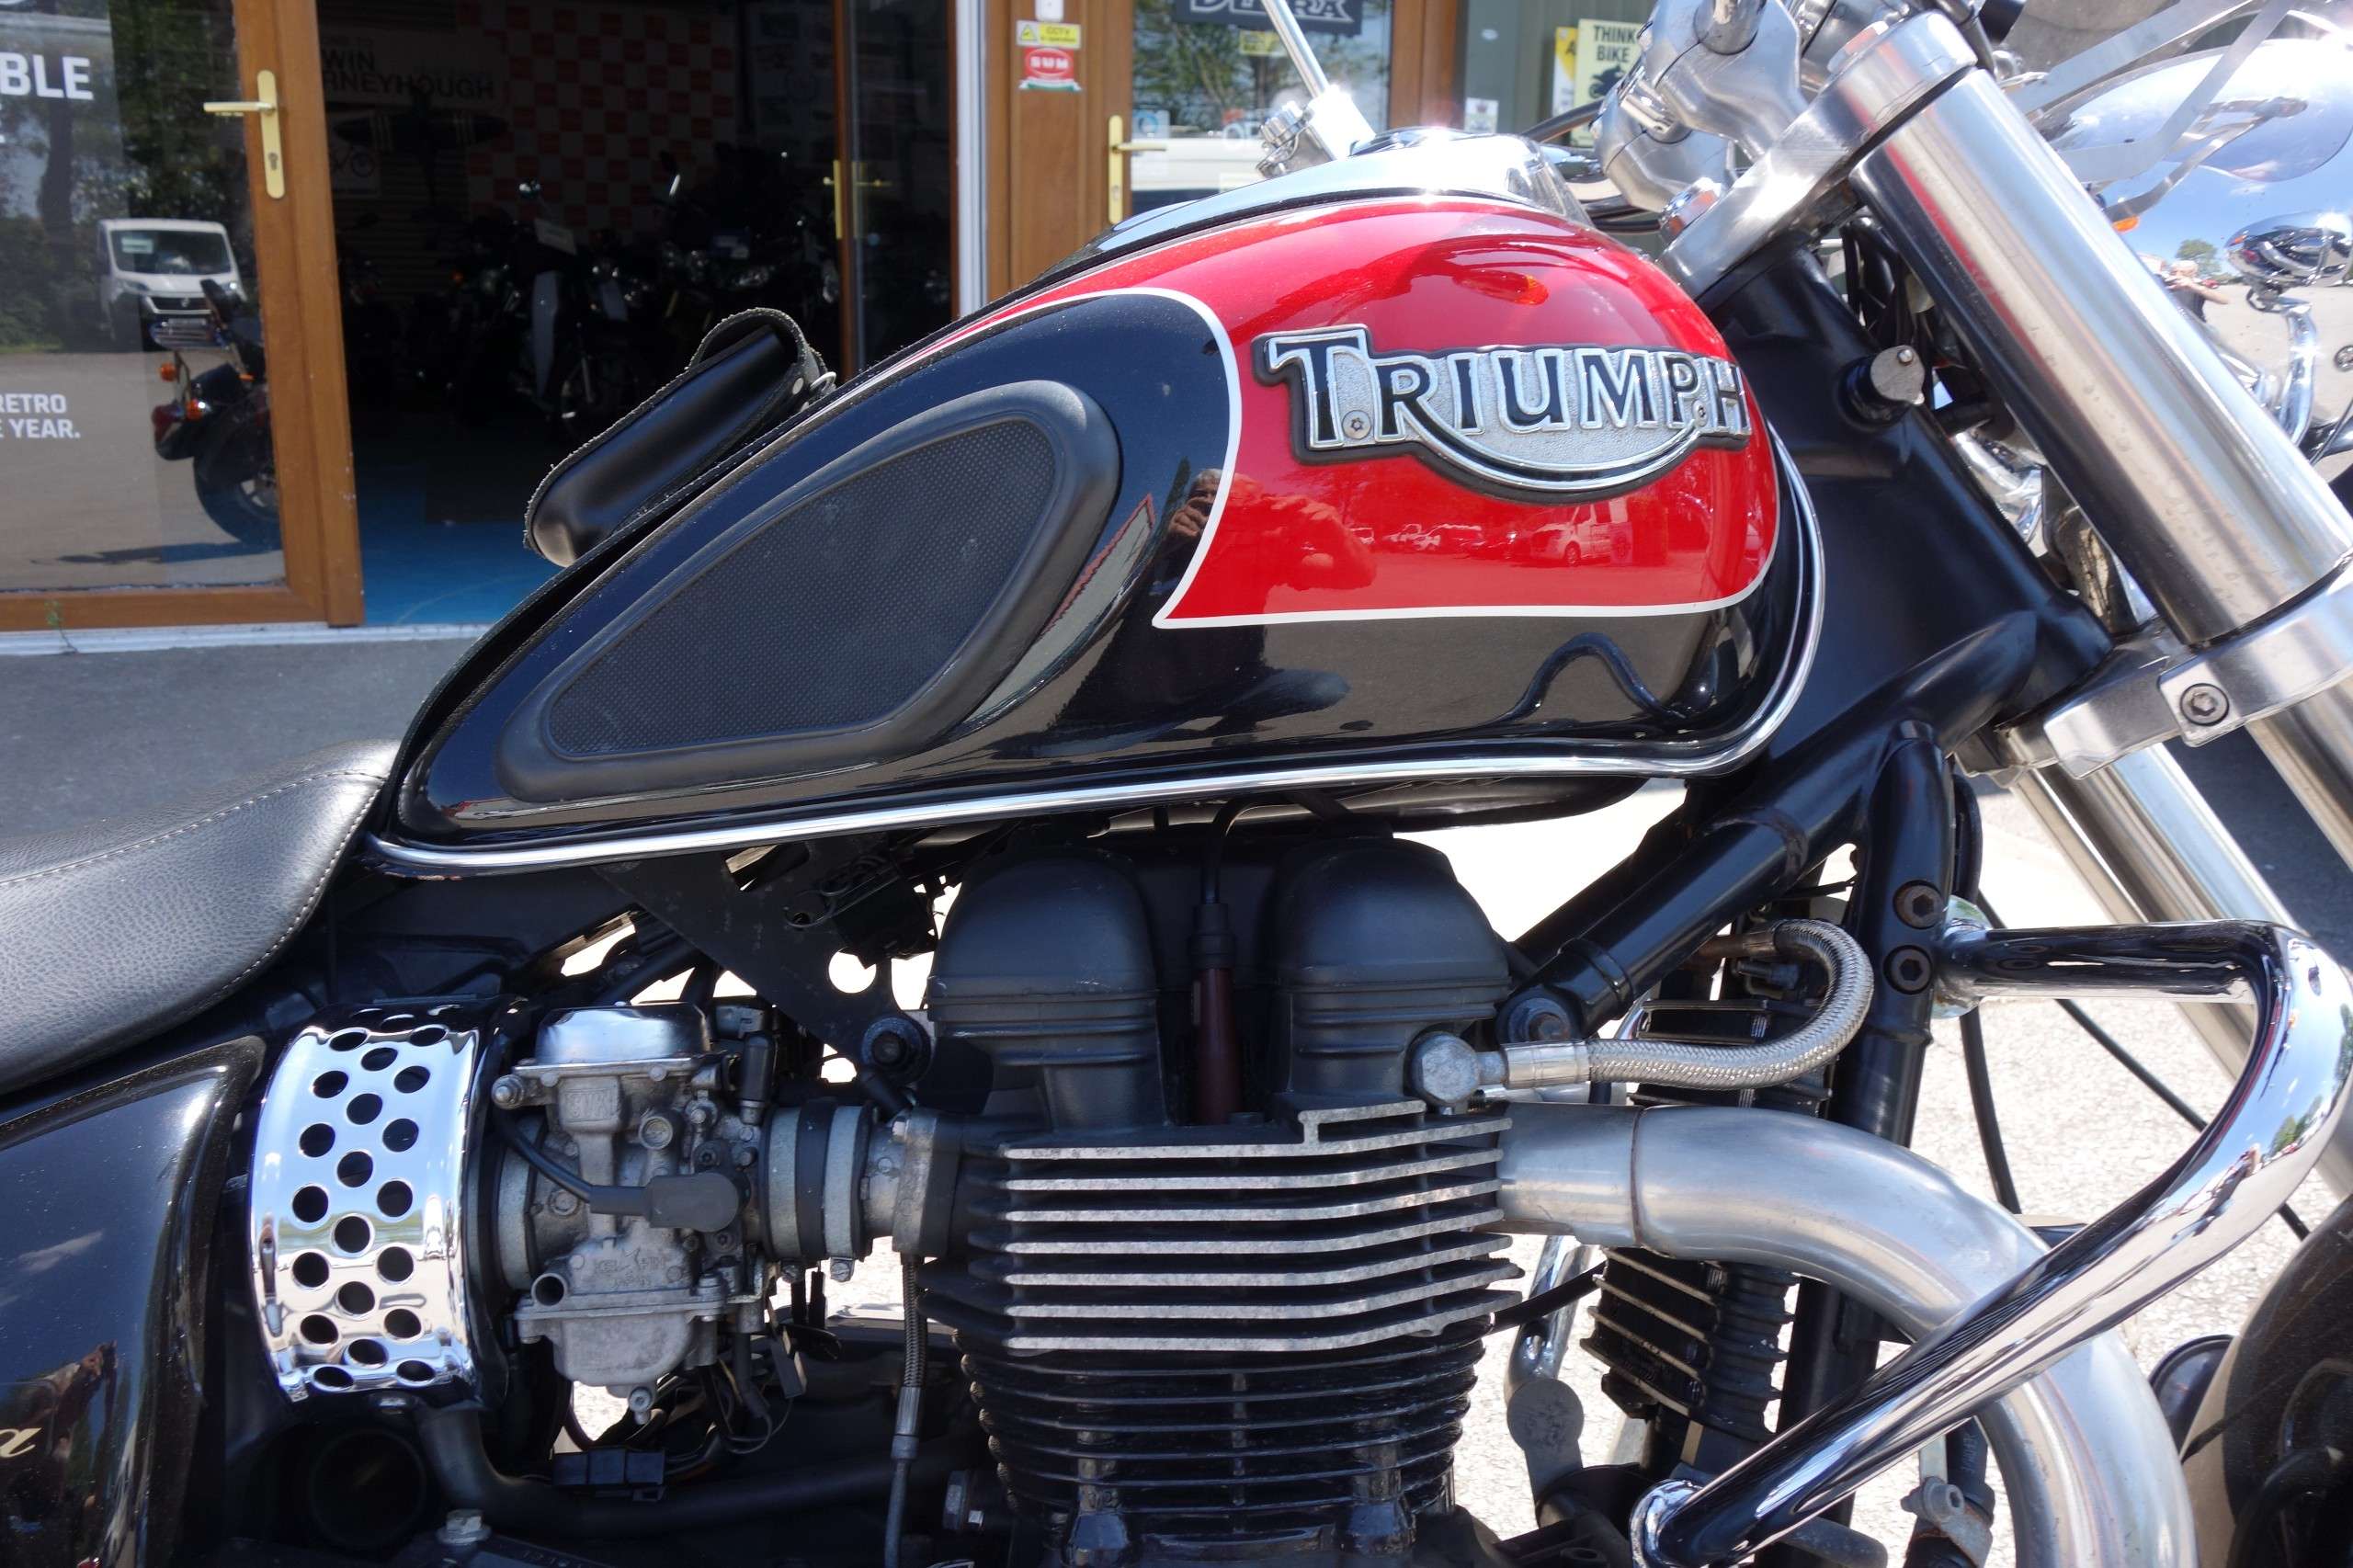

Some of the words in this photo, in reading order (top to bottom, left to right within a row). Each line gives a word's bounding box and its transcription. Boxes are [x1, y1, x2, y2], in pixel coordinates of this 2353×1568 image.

[1593, 24, 1637, 44] THINK
[1596, 45, 1631, 63] BIKE
[1268, 328, 1752, 490] TRIUMPH
[8, 418, 81, 439] YEAR.
